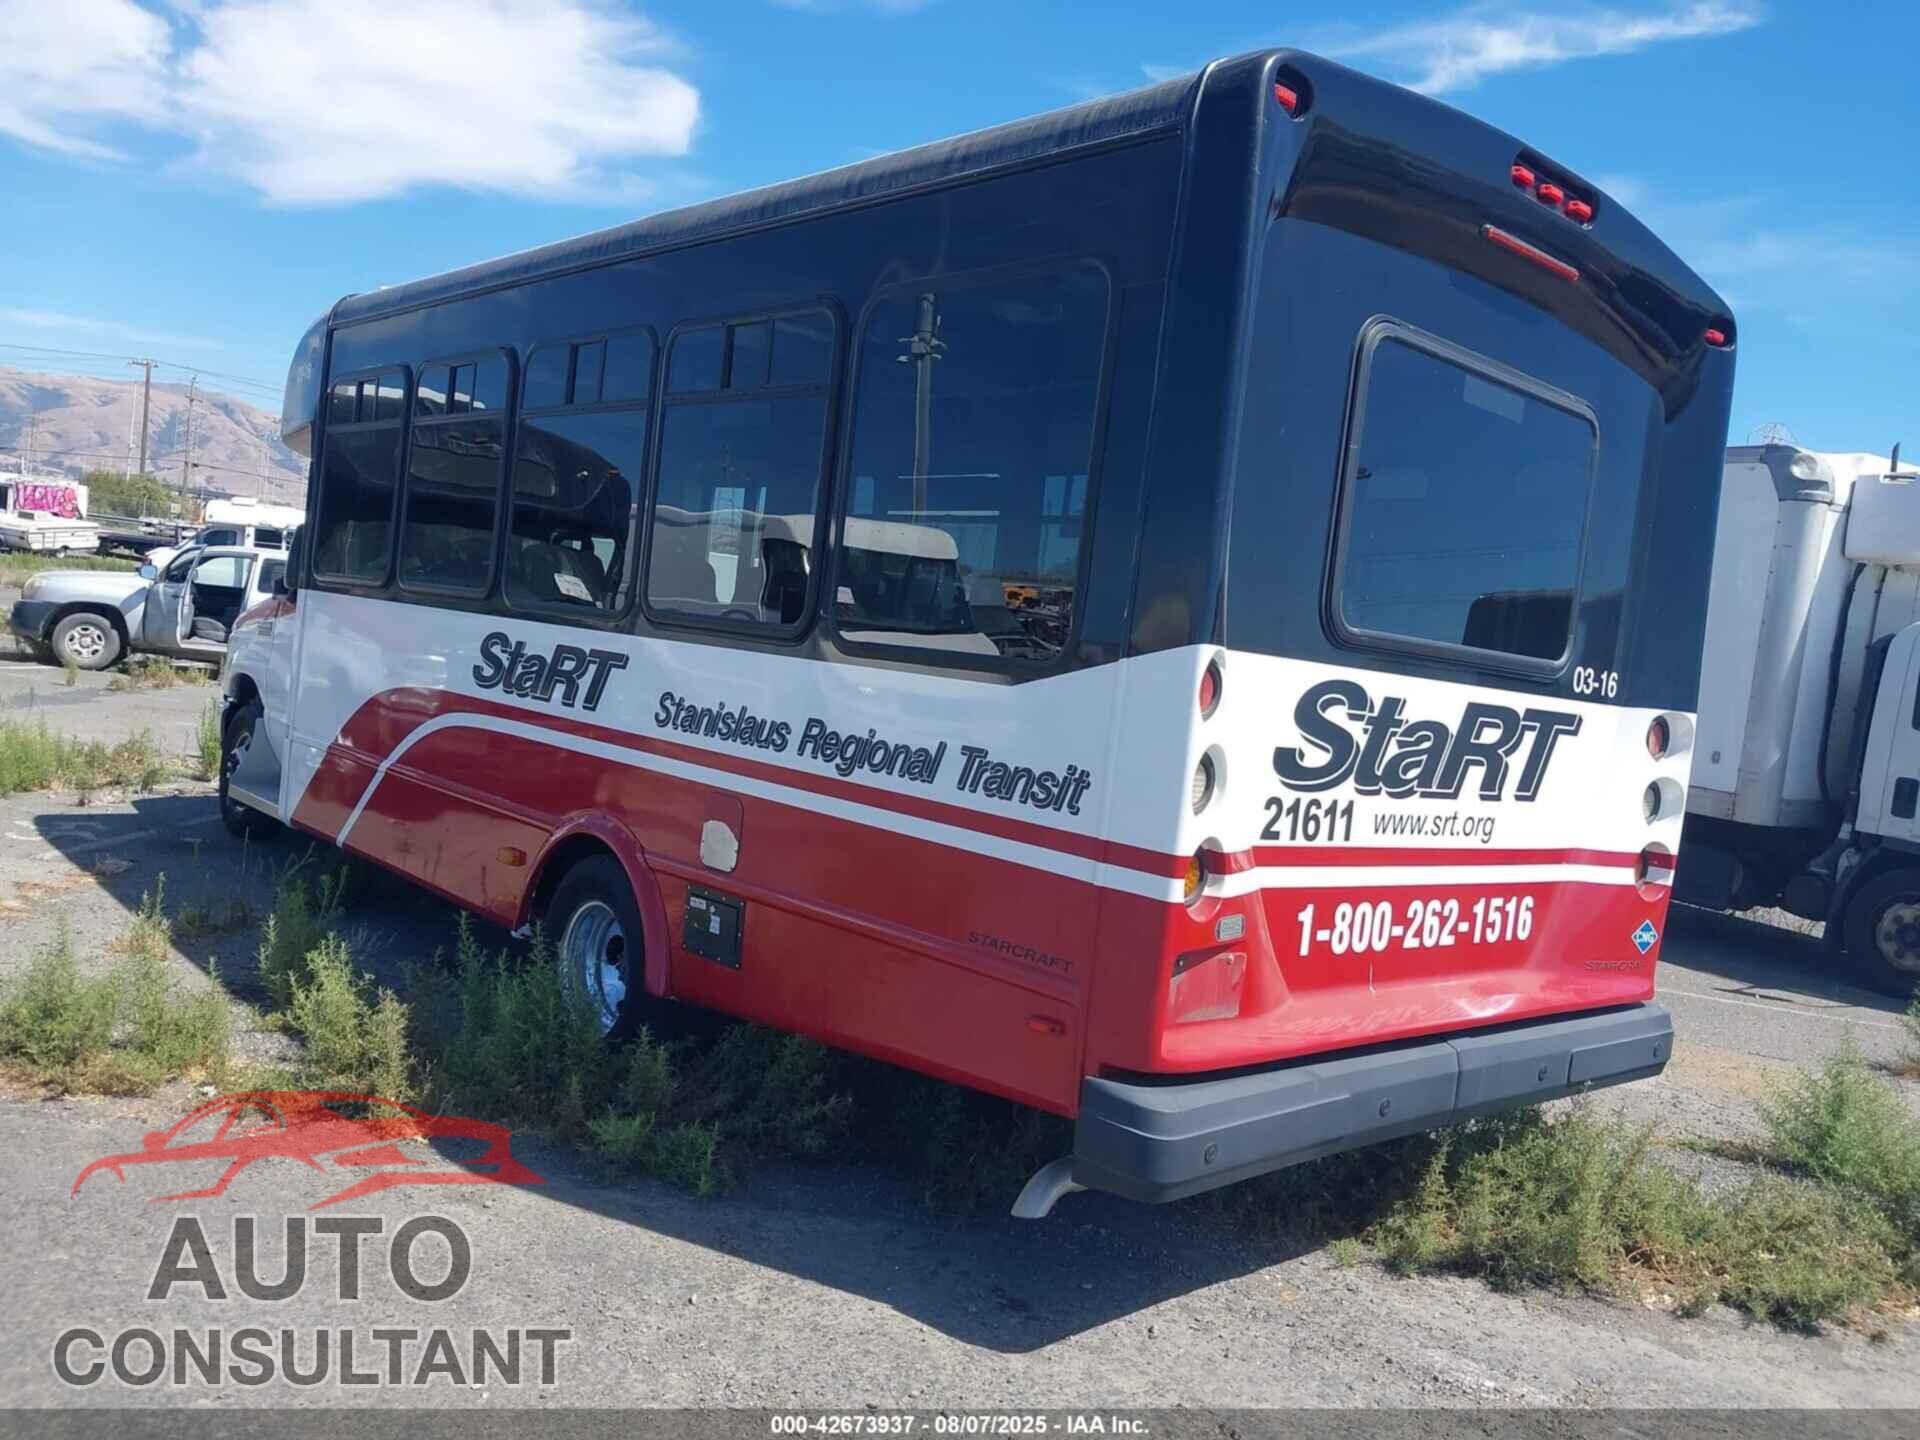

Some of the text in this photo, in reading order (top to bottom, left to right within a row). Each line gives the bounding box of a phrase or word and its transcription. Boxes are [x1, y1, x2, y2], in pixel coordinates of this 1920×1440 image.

[472, 632, 630, 711] StaRT
[1573, 666, 1618, 698] 03-16
[654, 691, 1091, 816] Stanislaus Regional Transit
[1273, 679, 1583, 802] StaRT
[1260, 796, 1355, 842] 21611
[1373, 811, 1496, 844] www.srt.org
[967, 931, 1073, 973] STARCRAFT
[1297, 895, 1535, 957] 1-800-262-1516
